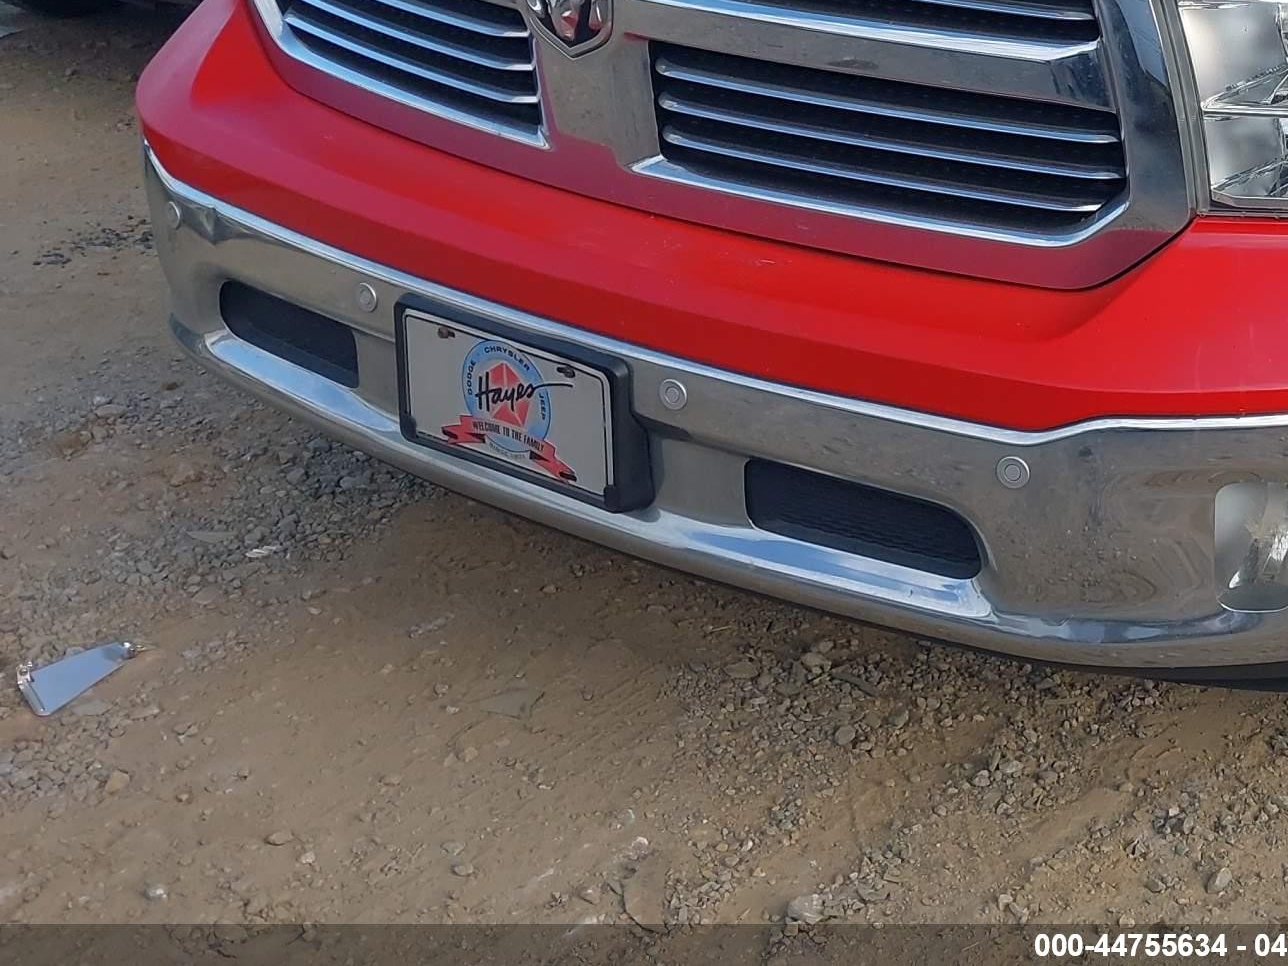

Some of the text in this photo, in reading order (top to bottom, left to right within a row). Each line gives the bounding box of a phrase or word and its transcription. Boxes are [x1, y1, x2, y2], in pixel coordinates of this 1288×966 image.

[484, 346, 531, 372] CHRYSLER
[466, 359, 477, 396] DODGE
[475, 370, 573, 412] Hayes
[538, 391, 547, 421] JEEP
[472, 420, 501, 435] WELCOME
[502, 425, 510, 437] TO
[511, 429, 523, 442] THE
[523, 433, 545, 452] FAMILY
